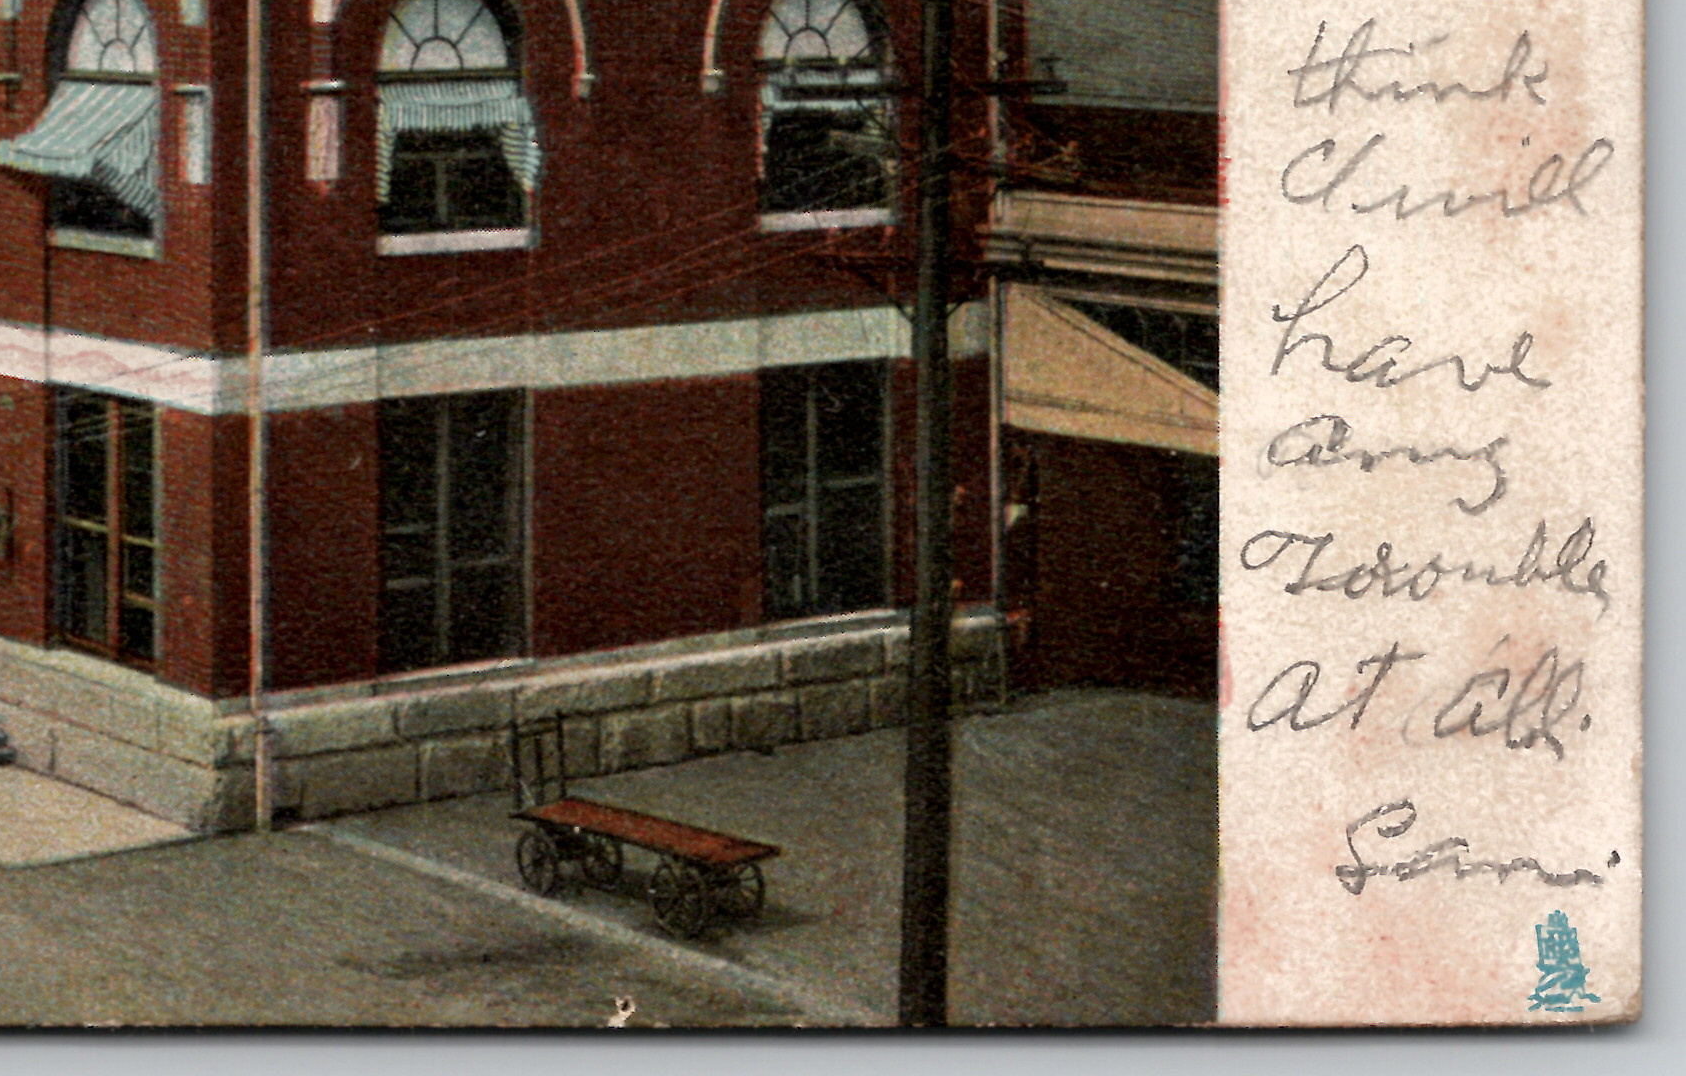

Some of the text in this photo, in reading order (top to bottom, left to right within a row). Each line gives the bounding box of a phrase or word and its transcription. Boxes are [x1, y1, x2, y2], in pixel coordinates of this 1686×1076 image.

[1287, 17, 1549, 115] think
[1350, 135, 1615, 221] will
[1270, 243, 1552, 393] have
